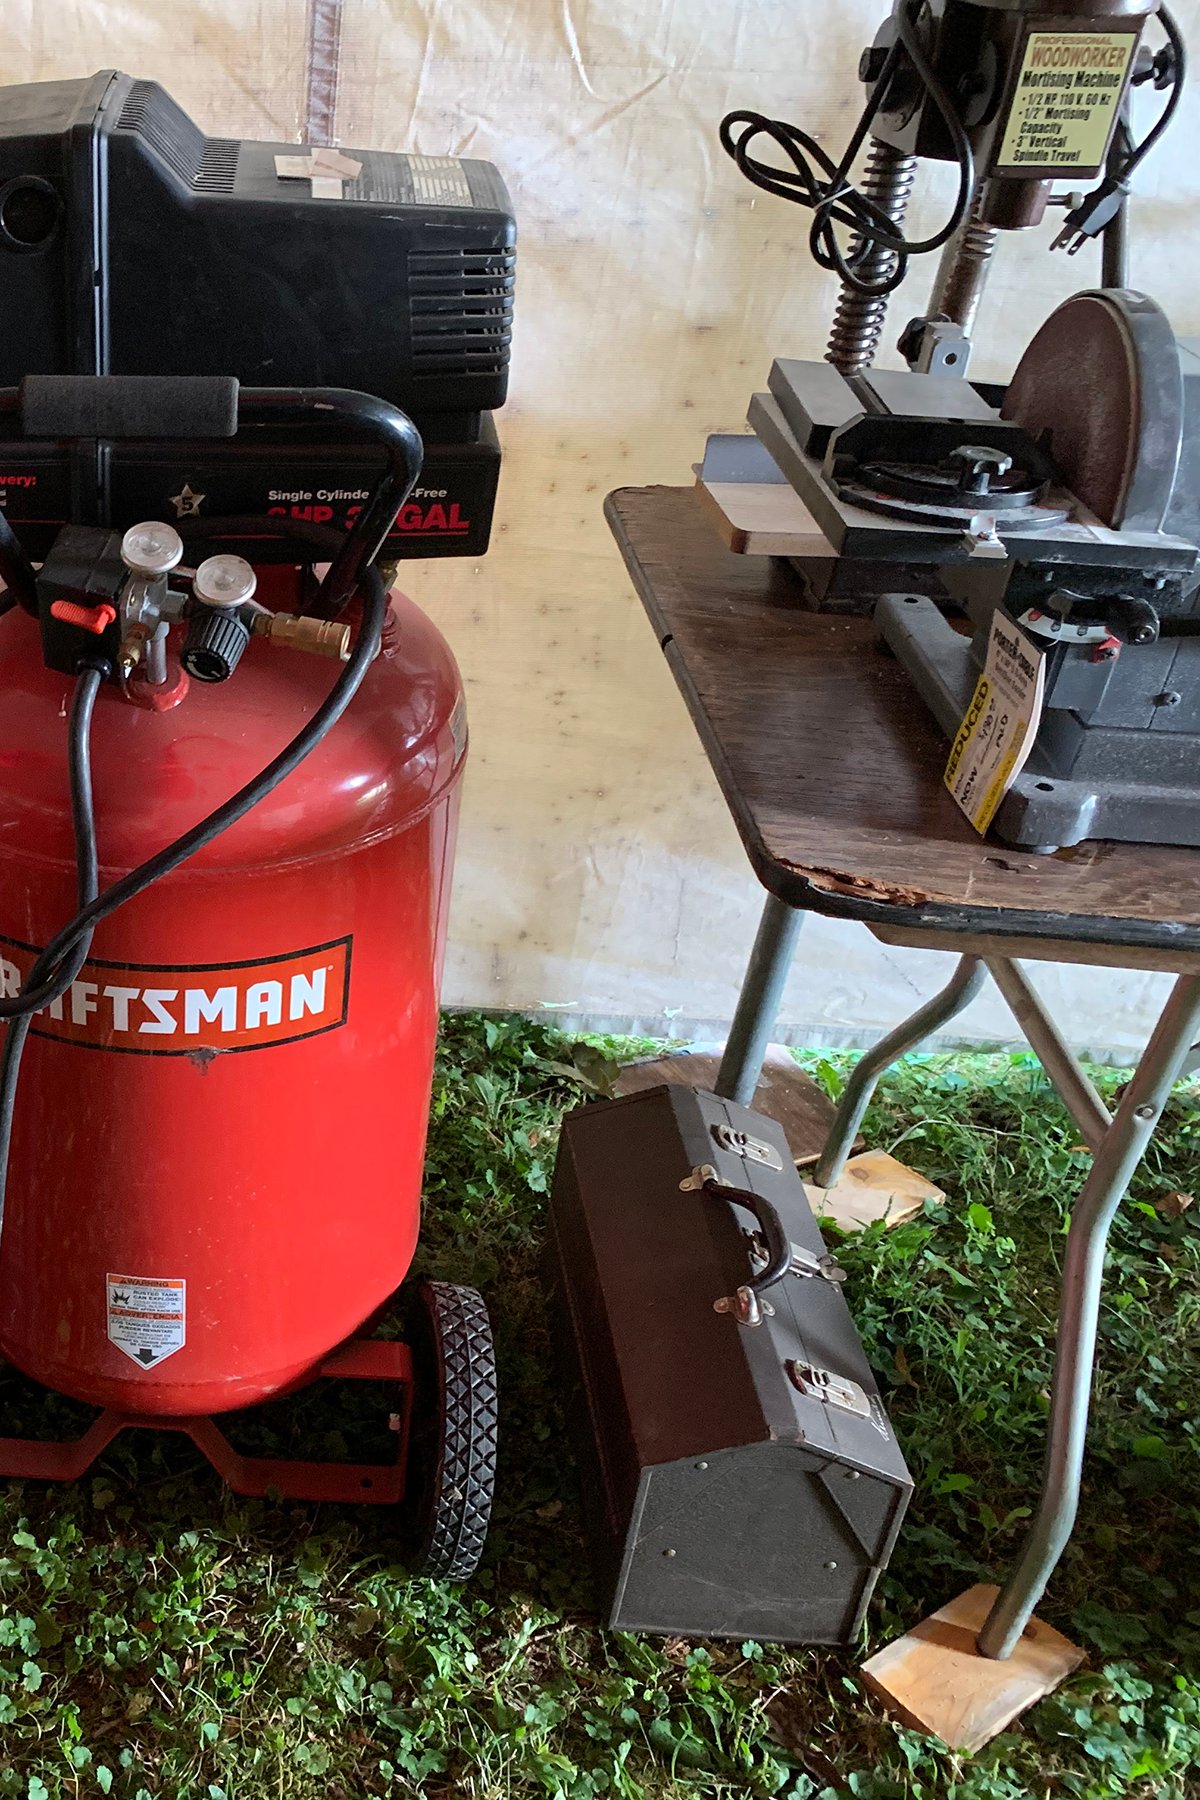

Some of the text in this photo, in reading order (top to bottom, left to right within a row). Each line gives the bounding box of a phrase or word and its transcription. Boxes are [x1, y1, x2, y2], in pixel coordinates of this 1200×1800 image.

[1033, 36, 1112, 45] PROFESSIONAL
[1030, 46, 1126, 67] WOODWORKER
[1021, 71, 1120, 89] Mortising Machine
[1044, 108, 1091, 120] Mortising
[1020, 122, 1062, 134] Capacity
[1028, 136, 1067, 147] Vertical
[1012, 150, 1080, 162] Spindle Travel
[268, 490, 312, 502] Single
[316, 489, 370, 501] Cylinde
[397, 503, 470, 529] GAL
[946, 681, 989, 784] REDUCED
[960, 766, 978, 805] NOW
